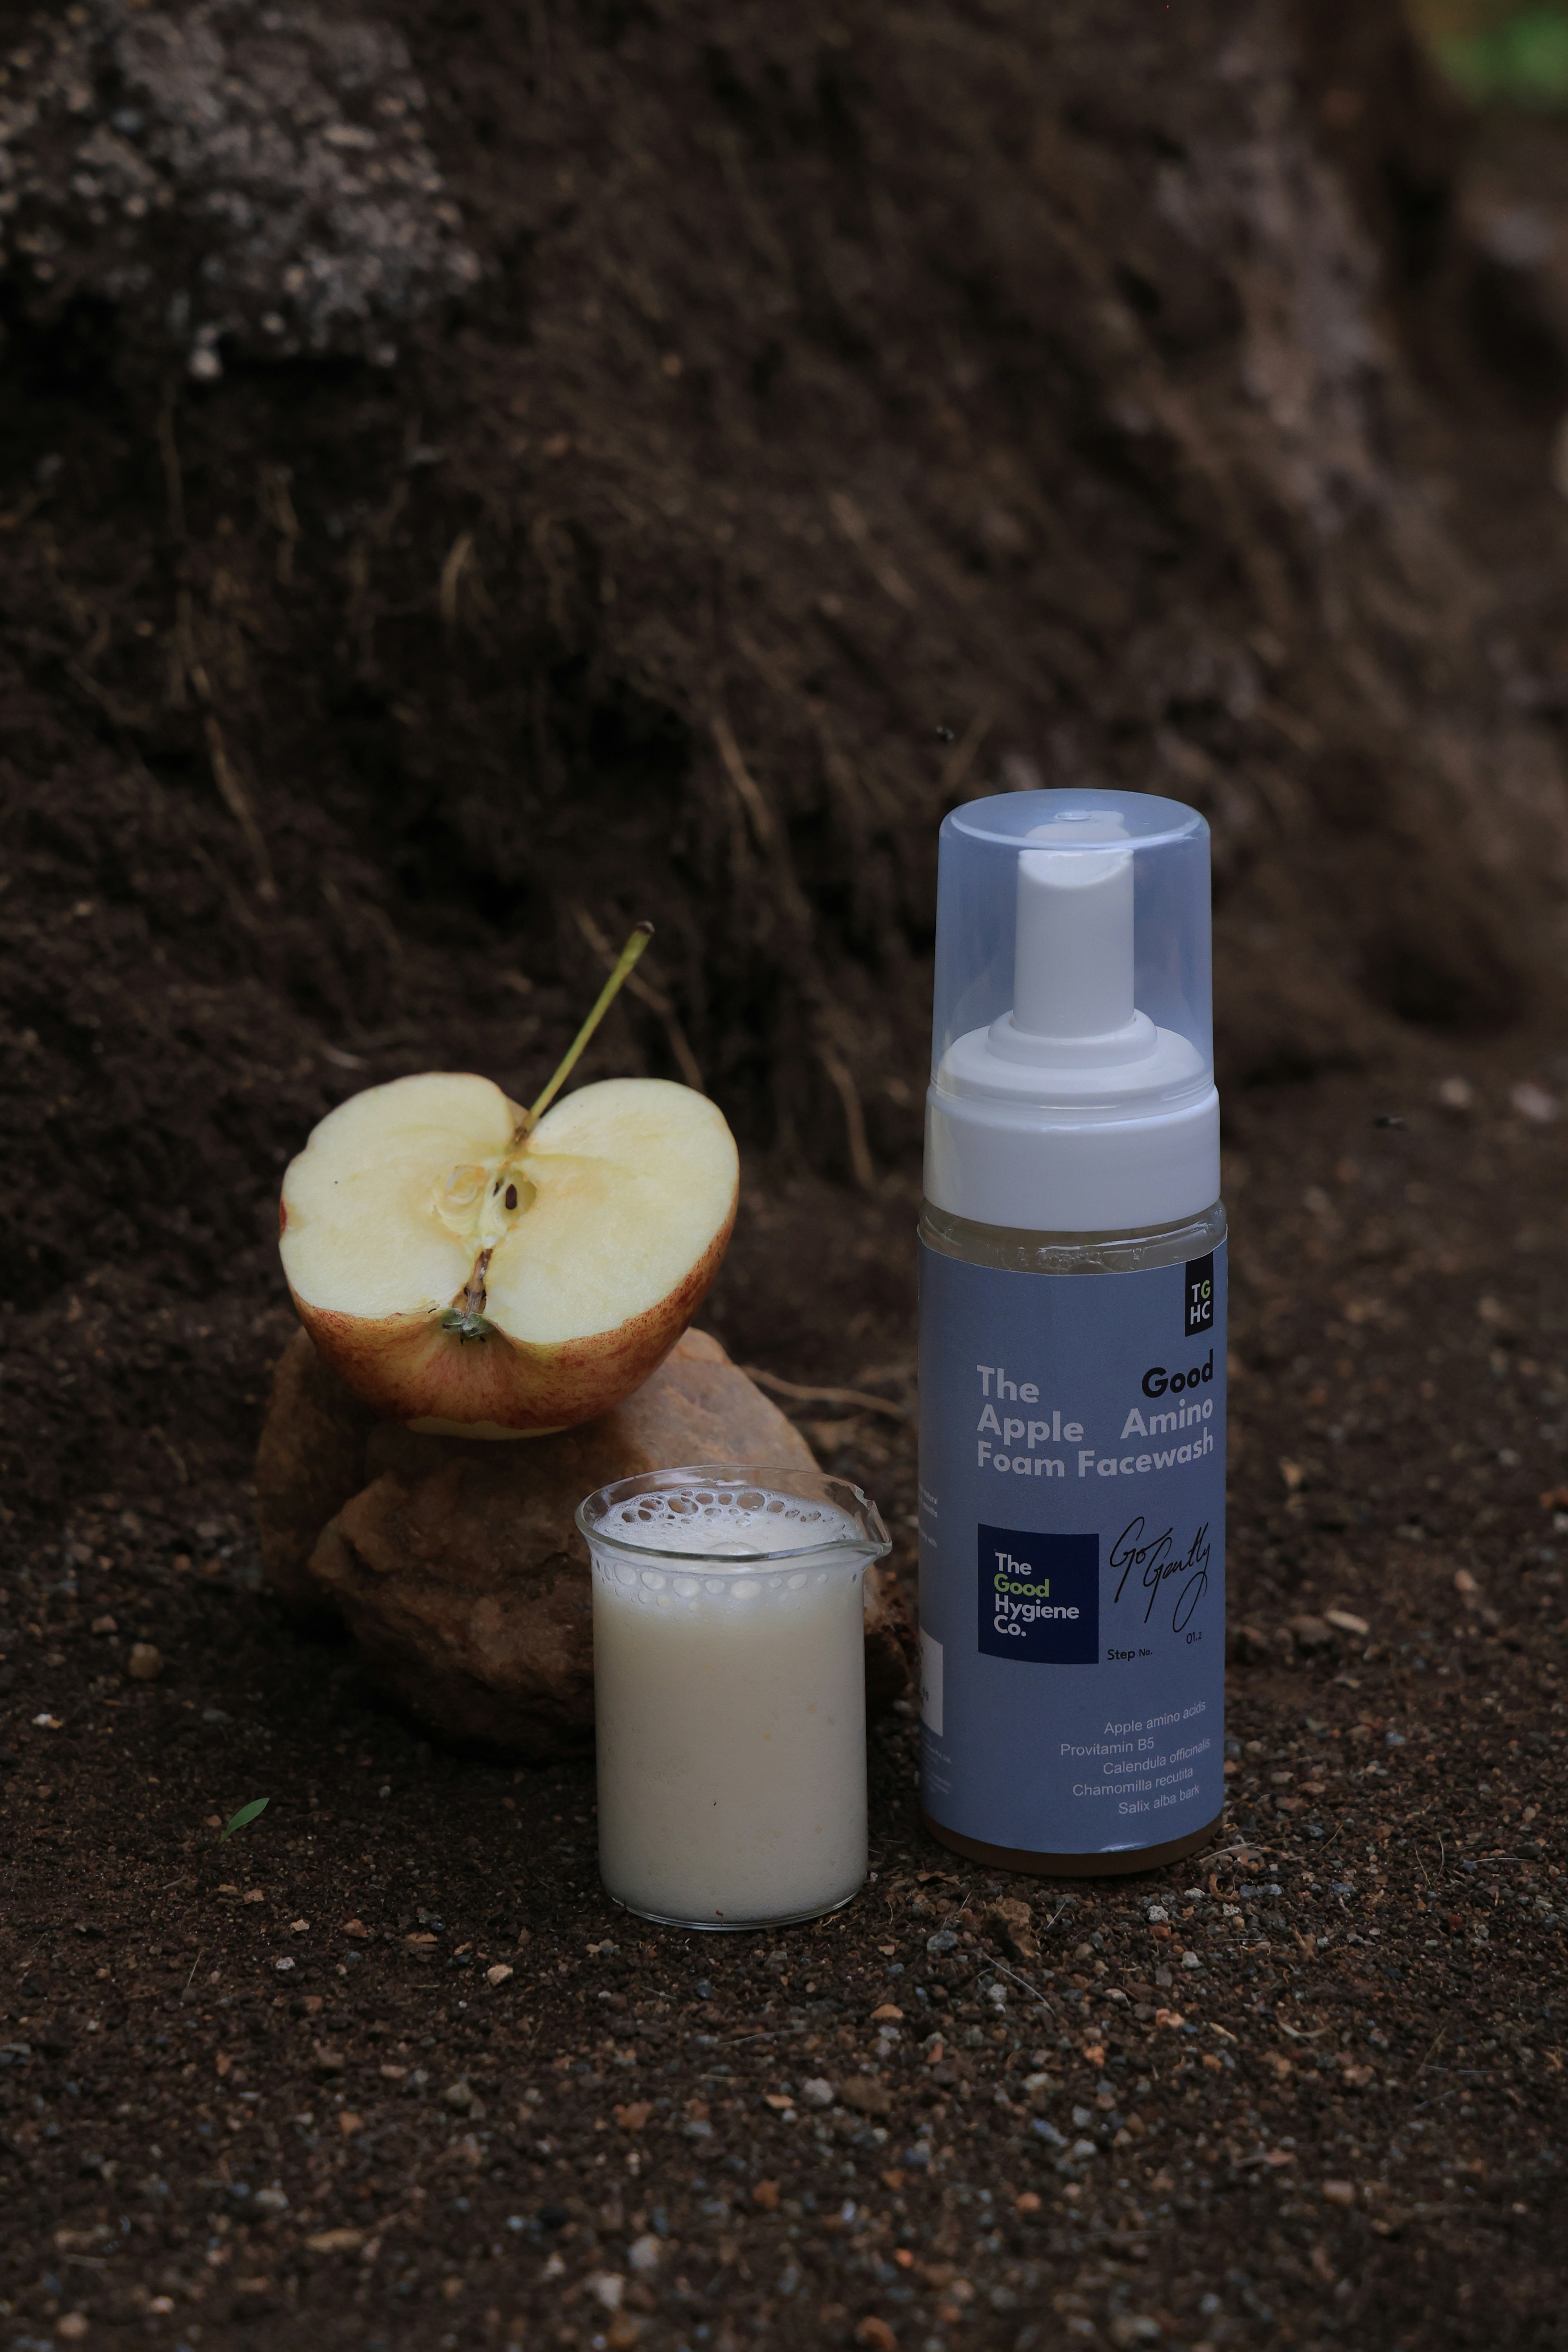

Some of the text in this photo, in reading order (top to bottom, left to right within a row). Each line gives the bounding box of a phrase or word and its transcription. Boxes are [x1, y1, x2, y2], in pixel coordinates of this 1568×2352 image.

[977, 1348, 1213, 1403] The Good
[976, 1398, 1212, 1448] Apple Amino
[977, 1426, 1213, 1477] Foam Facewash
[995, 1552, 1031, 1575] The
[1109, 1516, 1172, 1603] Go
[994, 1573, 1049, 1597] Good
[995, 1594, 1079, 1622] Hygiene
[994, 1615, 1026, 1637] Co.
[1107, 1648, 1135, 1661] Step
[1138, 1648, 1152, 1657] No.
[1104, 1700, 1205, 1736] Apple amino acids
[1061, 1737, 1154, 1755] Provitamin B5
[1103, 1737, 1210, 1775] Calendula officinalis
[1073, 1766, 1193, 1796] Chamomilla recutita
[1118, 1783, 1199, 1814] Salix alba bark
